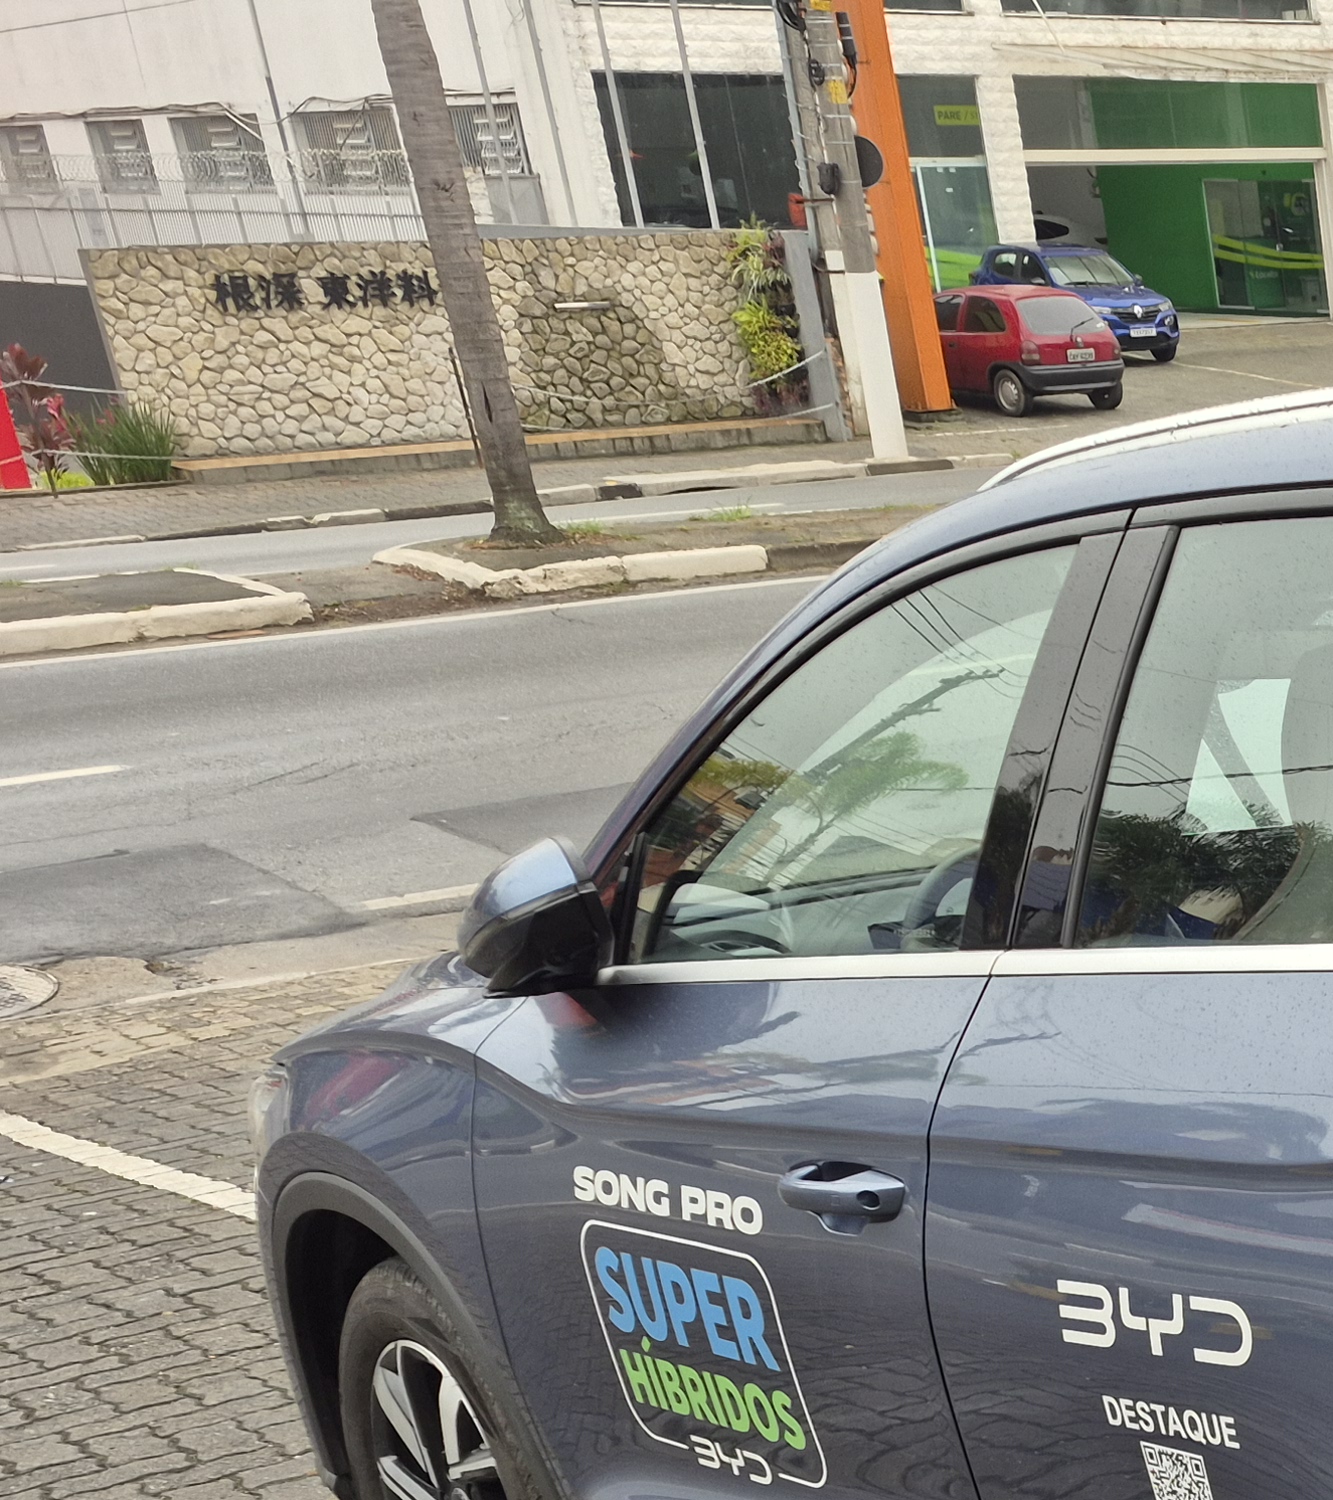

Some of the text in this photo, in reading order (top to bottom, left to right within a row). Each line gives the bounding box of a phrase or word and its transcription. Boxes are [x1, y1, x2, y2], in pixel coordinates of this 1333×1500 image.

[315, 268, 440, 310] 東洋料
[573, 1166, 763, 1235] SONG PRO
[595, 1246, 782, 1373] SUPER
[1056, 1279, 1253, 1367] BYD
[619, 1336, 807, 1450] HÍBRIDOS
[1101, 1394, 1241, 1449] DESTAQUE
[689, 1434, 773, 1485] BYD
